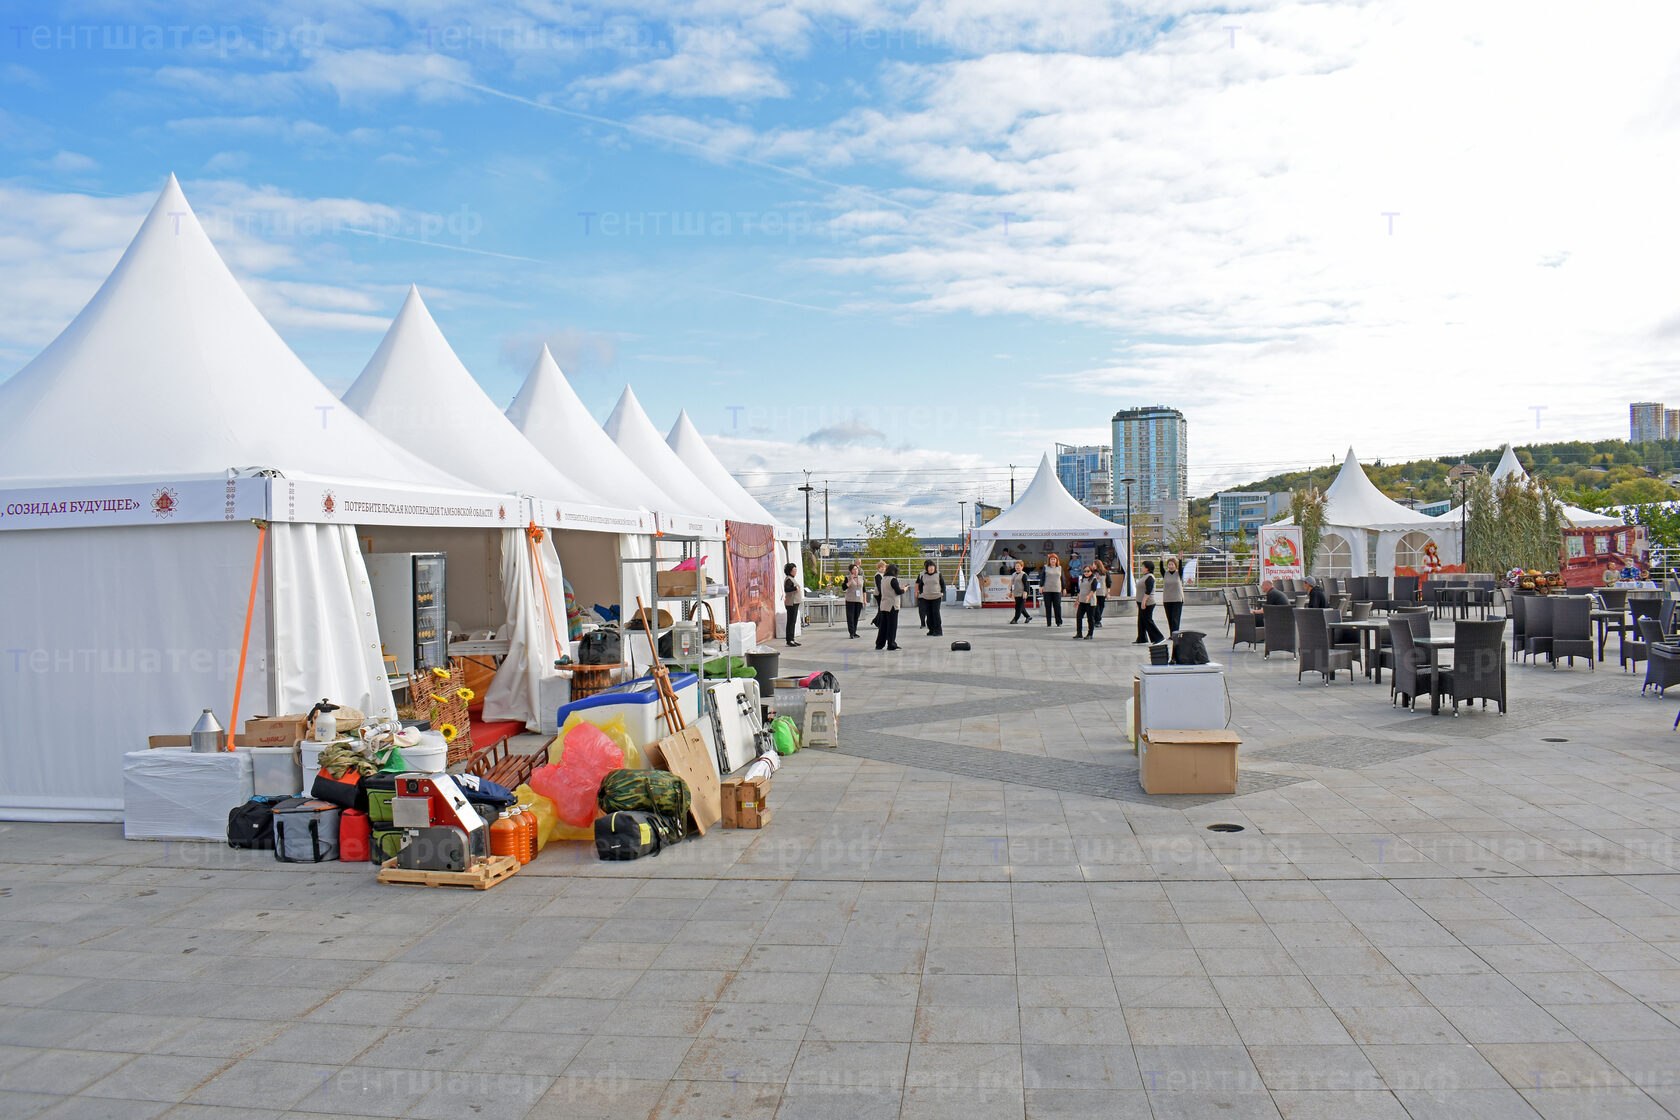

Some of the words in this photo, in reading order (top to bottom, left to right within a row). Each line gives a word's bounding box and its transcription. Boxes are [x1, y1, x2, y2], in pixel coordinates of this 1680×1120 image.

[7, 502, 67, 515] СОЗИДАЯ
[69, 499, 140, 514] БУДУЩЕЕ»
[344, 501, 404, 514] ПОТРЕБИТЕЛЬСКАЯ
[404, 504, 440, 516] КООПЕРАЦИЯ
[440, 506, 473, 517] ТАМБОВСКОЙ
[473, 508, 494, 517] ОБЛАСТИ
